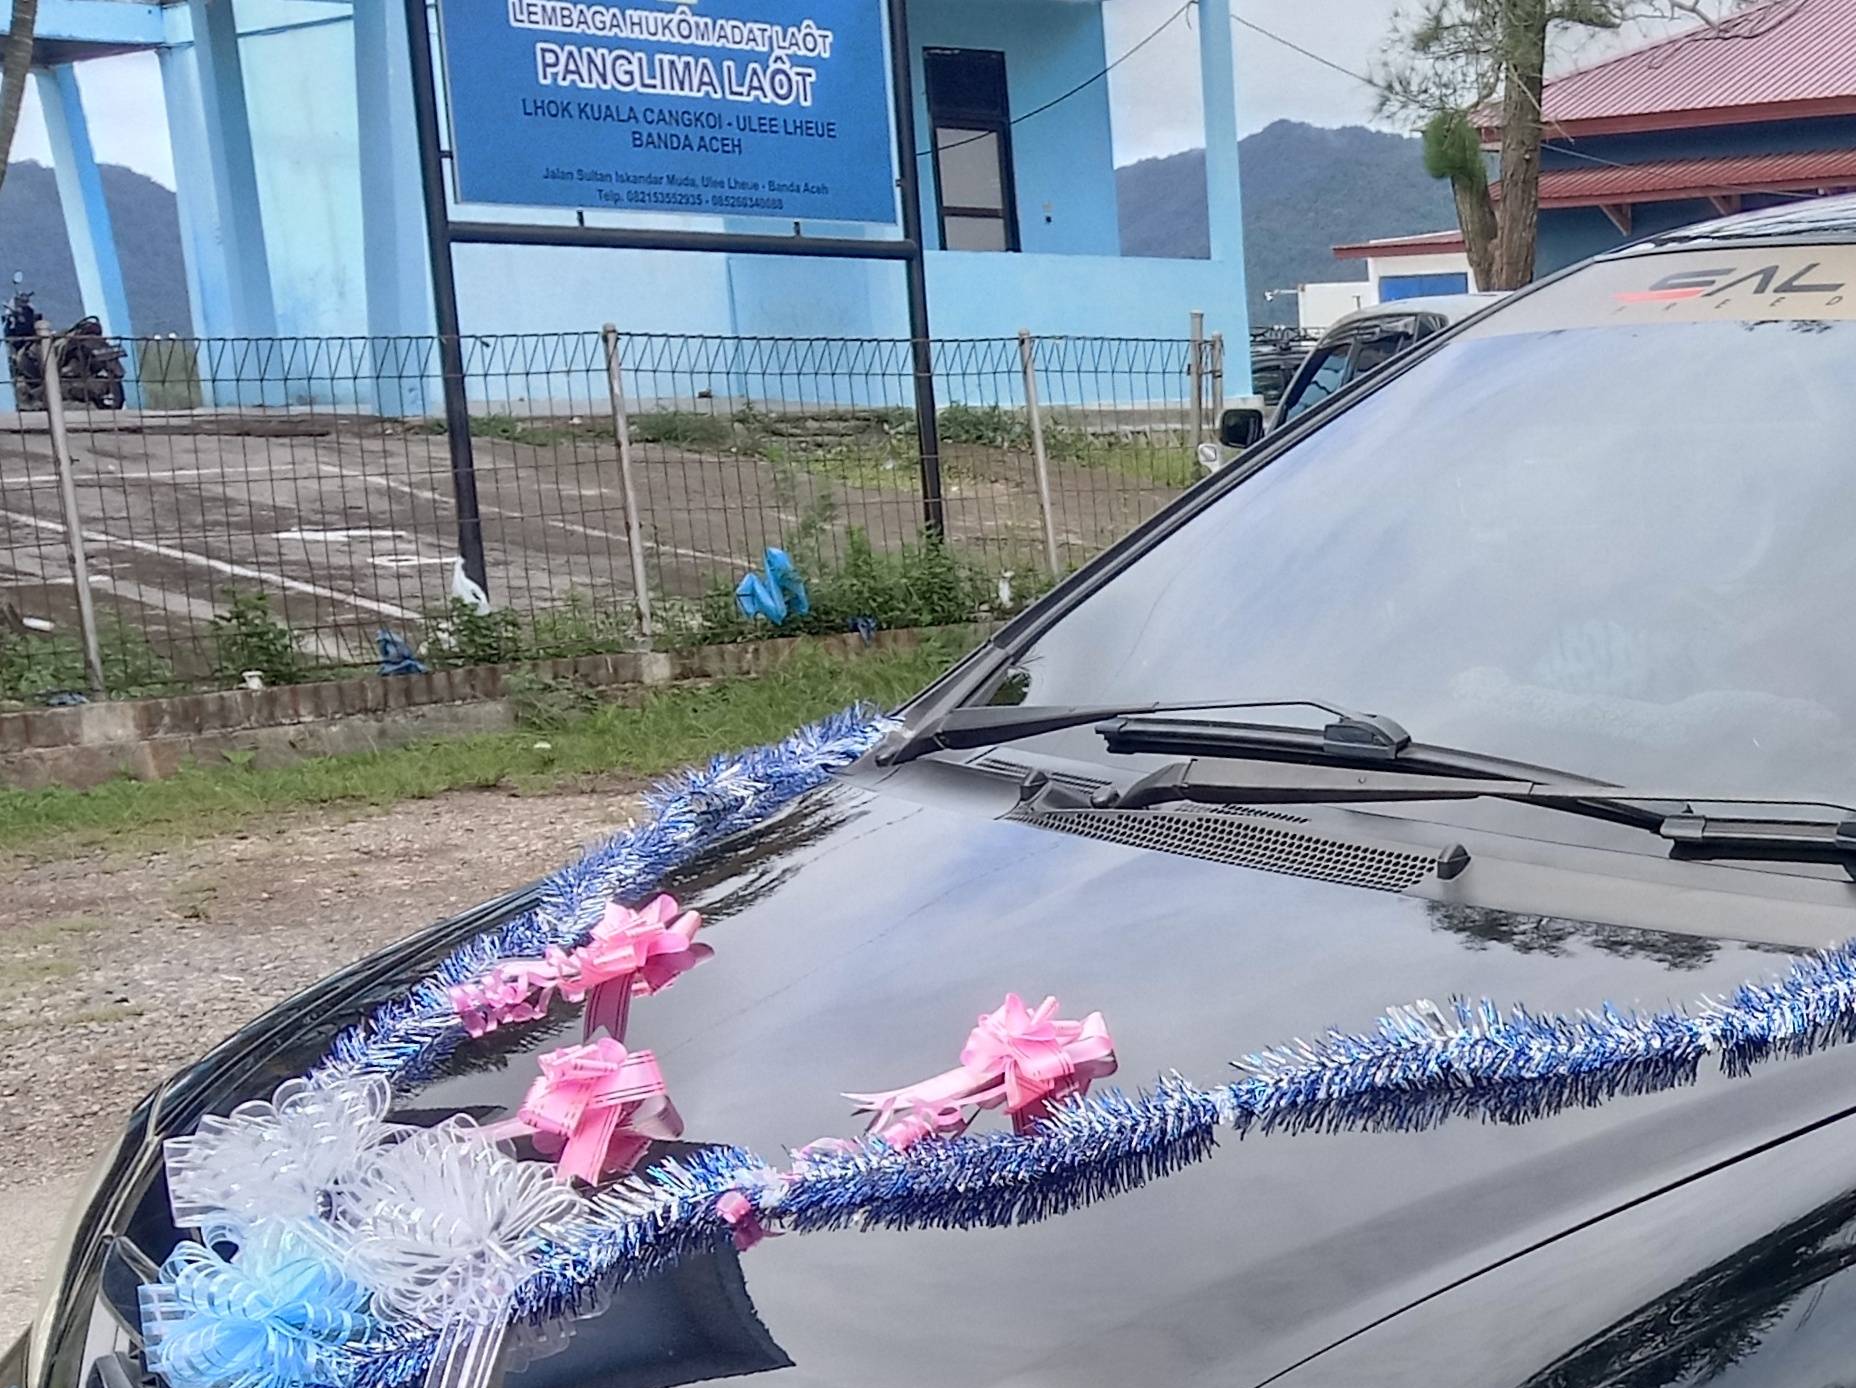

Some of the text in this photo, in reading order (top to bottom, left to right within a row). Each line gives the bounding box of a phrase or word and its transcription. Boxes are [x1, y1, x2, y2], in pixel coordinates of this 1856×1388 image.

[511, 0, 831, 56] LEMBAGA HUKÔM ADAT LAÔT
[537, 43, 815, 105] PANGLIMA LAÔT
[521, 98, 574, 119] LHOK
[578, 102, 639, 124] KUALA
[643, 108, 723, 130] CANGKOI
[736, 115, 780, 134] ULEE
[784, 118, 837, 138] LHEUE
[631, 130, 742, 155] BANDA ACEH
[543, 168, 574, 182] Jalan
[576, 169, 613, 183] Sultan
[615, 171, 664, 186] Iskandar
[701, 176, 725, 189] Ulee
[727, 177, 760, 192] Lheue
[768, 180, 800, 194] Banda
[802, 182, 829, 195] Aceh
[597, 189, 624, 205] Telp.
